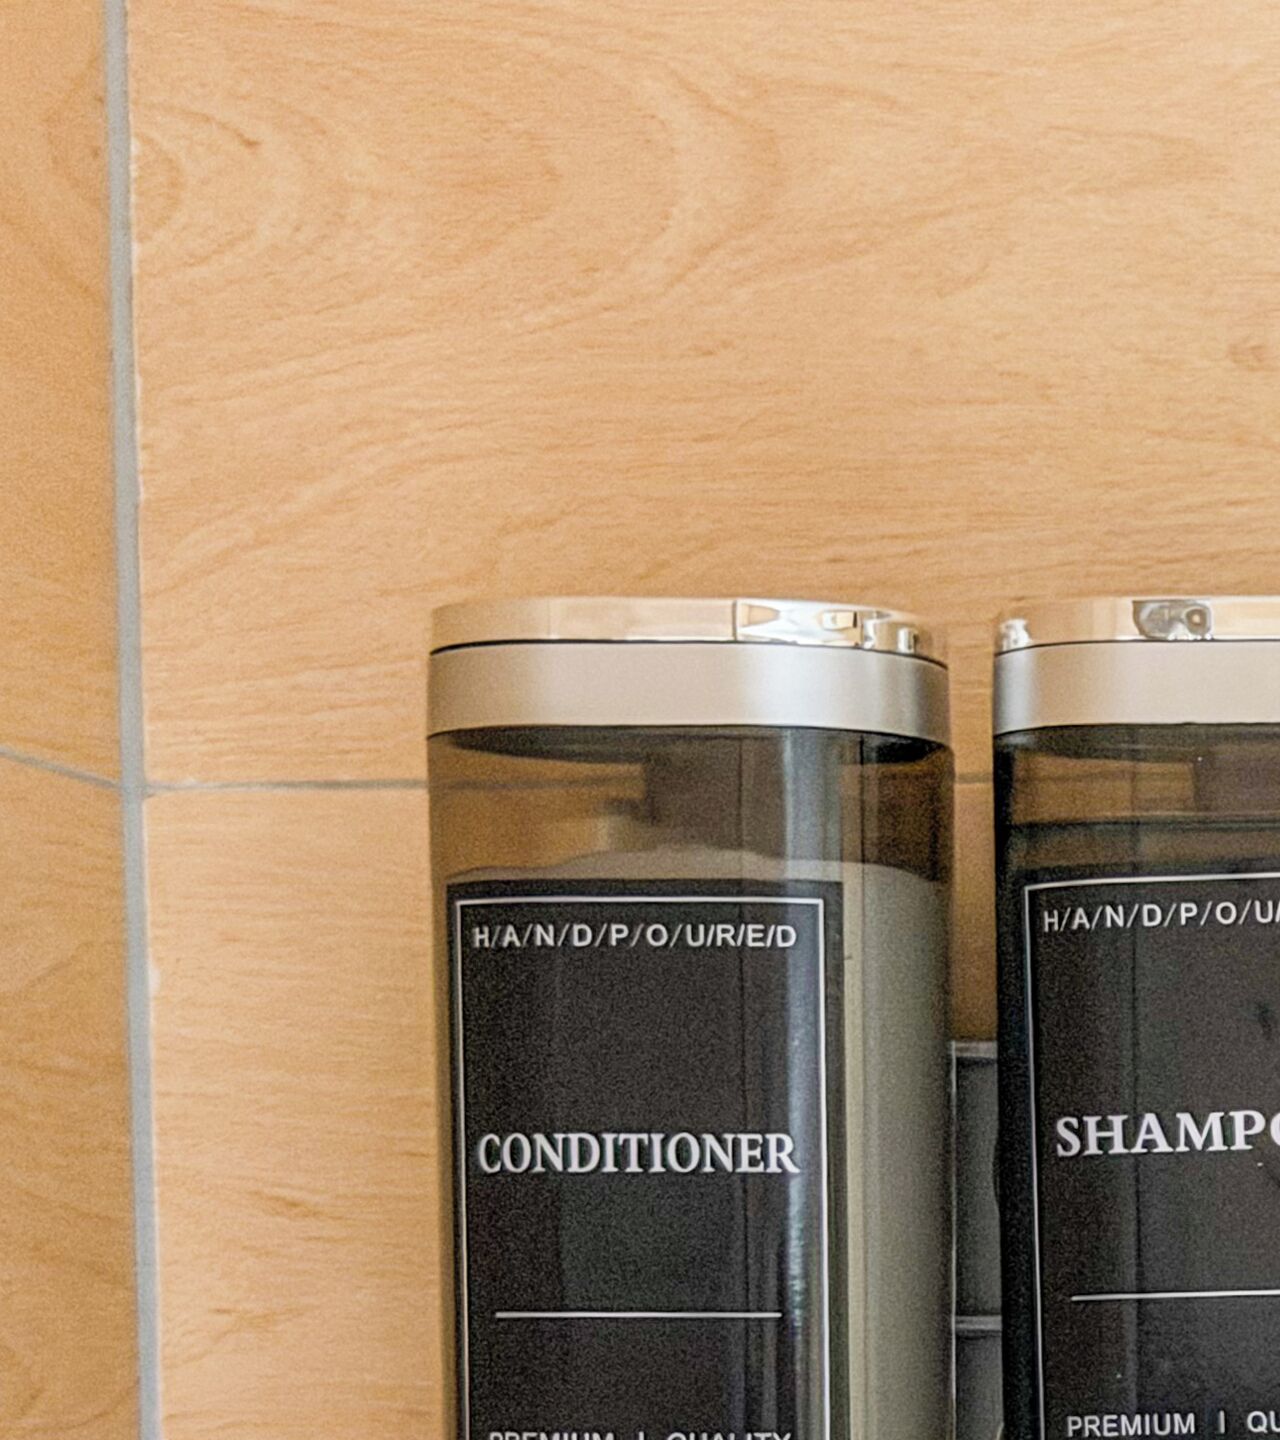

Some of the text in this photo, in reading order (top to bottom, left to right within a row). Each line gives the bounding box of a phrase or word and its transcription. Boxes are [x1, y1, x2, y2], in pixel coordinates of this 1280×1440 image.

[472, 923, 797, 949] H/A/N/D/P/O/U/R/E/D
[477, 1131, 801, 1175] CONDITIONER
[1066, 1412, 1196, 1438] PREMIUM
